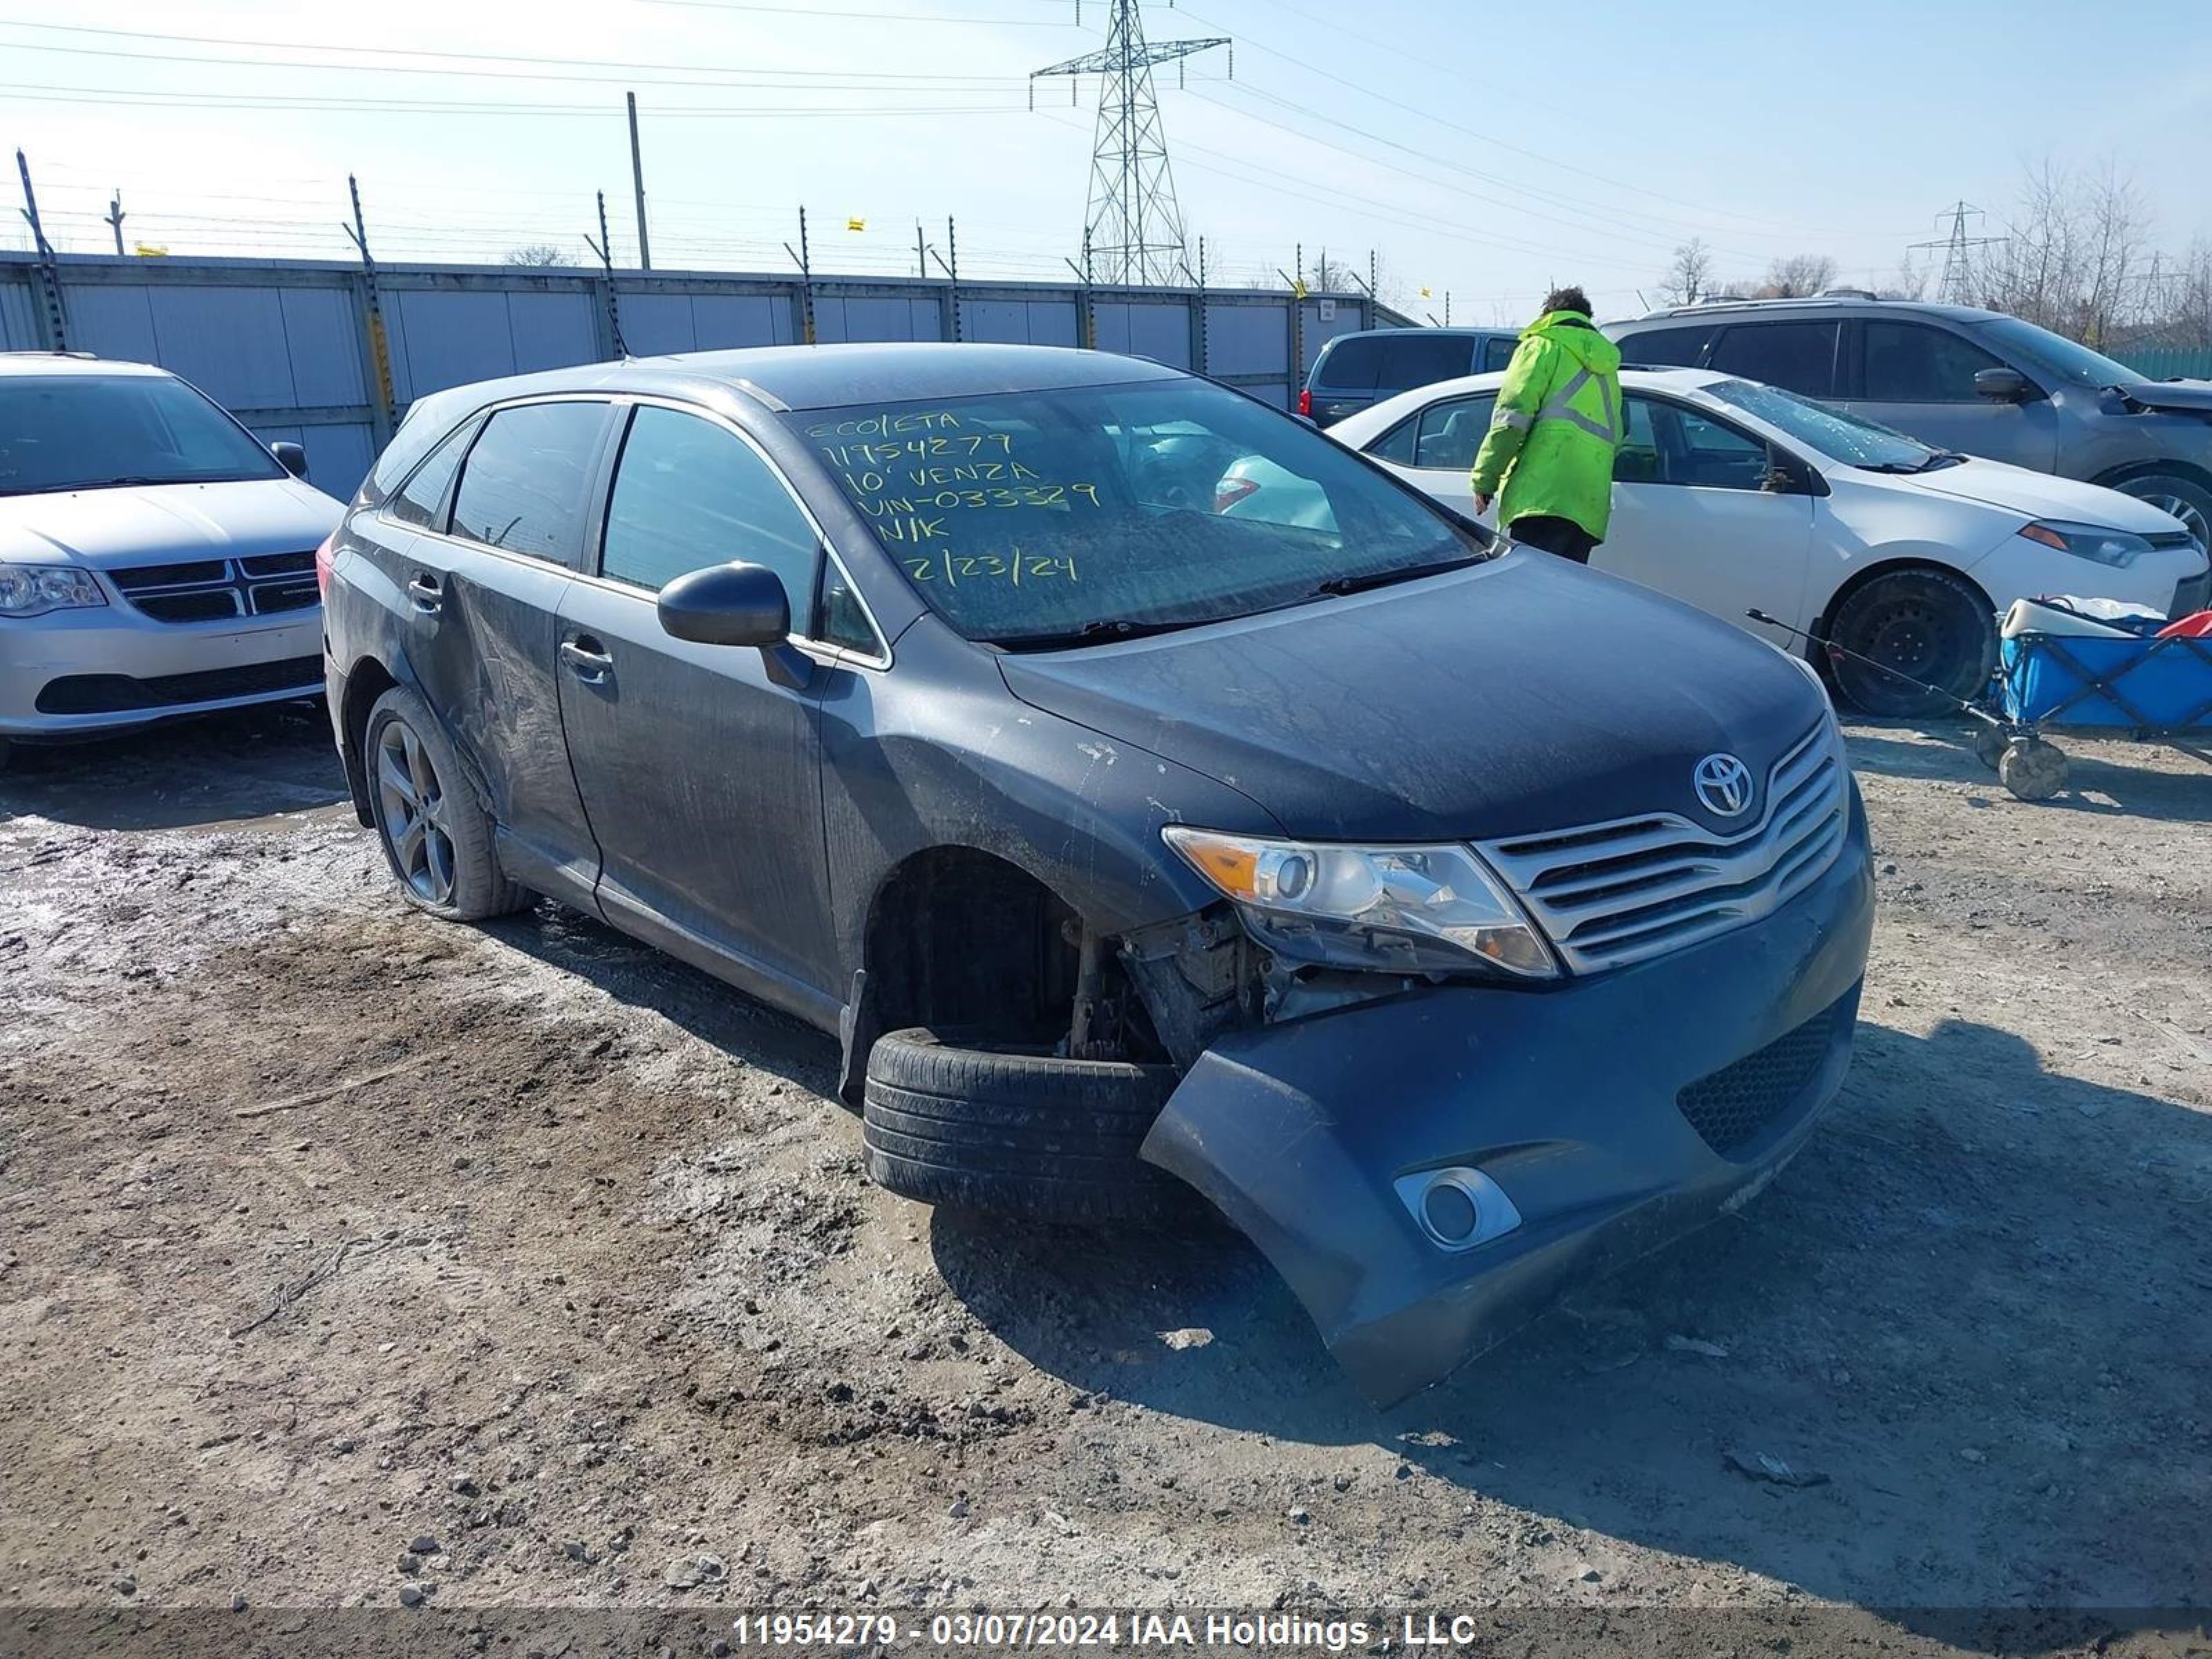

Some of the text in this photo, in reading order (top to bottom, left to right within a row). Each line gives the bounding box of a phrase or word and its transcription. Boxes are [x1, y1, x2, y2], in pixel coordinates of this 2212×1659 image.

[822, 433, 1011, 467] 11954279
[910, 462, 1040, 486] VENZA
[903, 546, 1078, 588] 2/23/24
